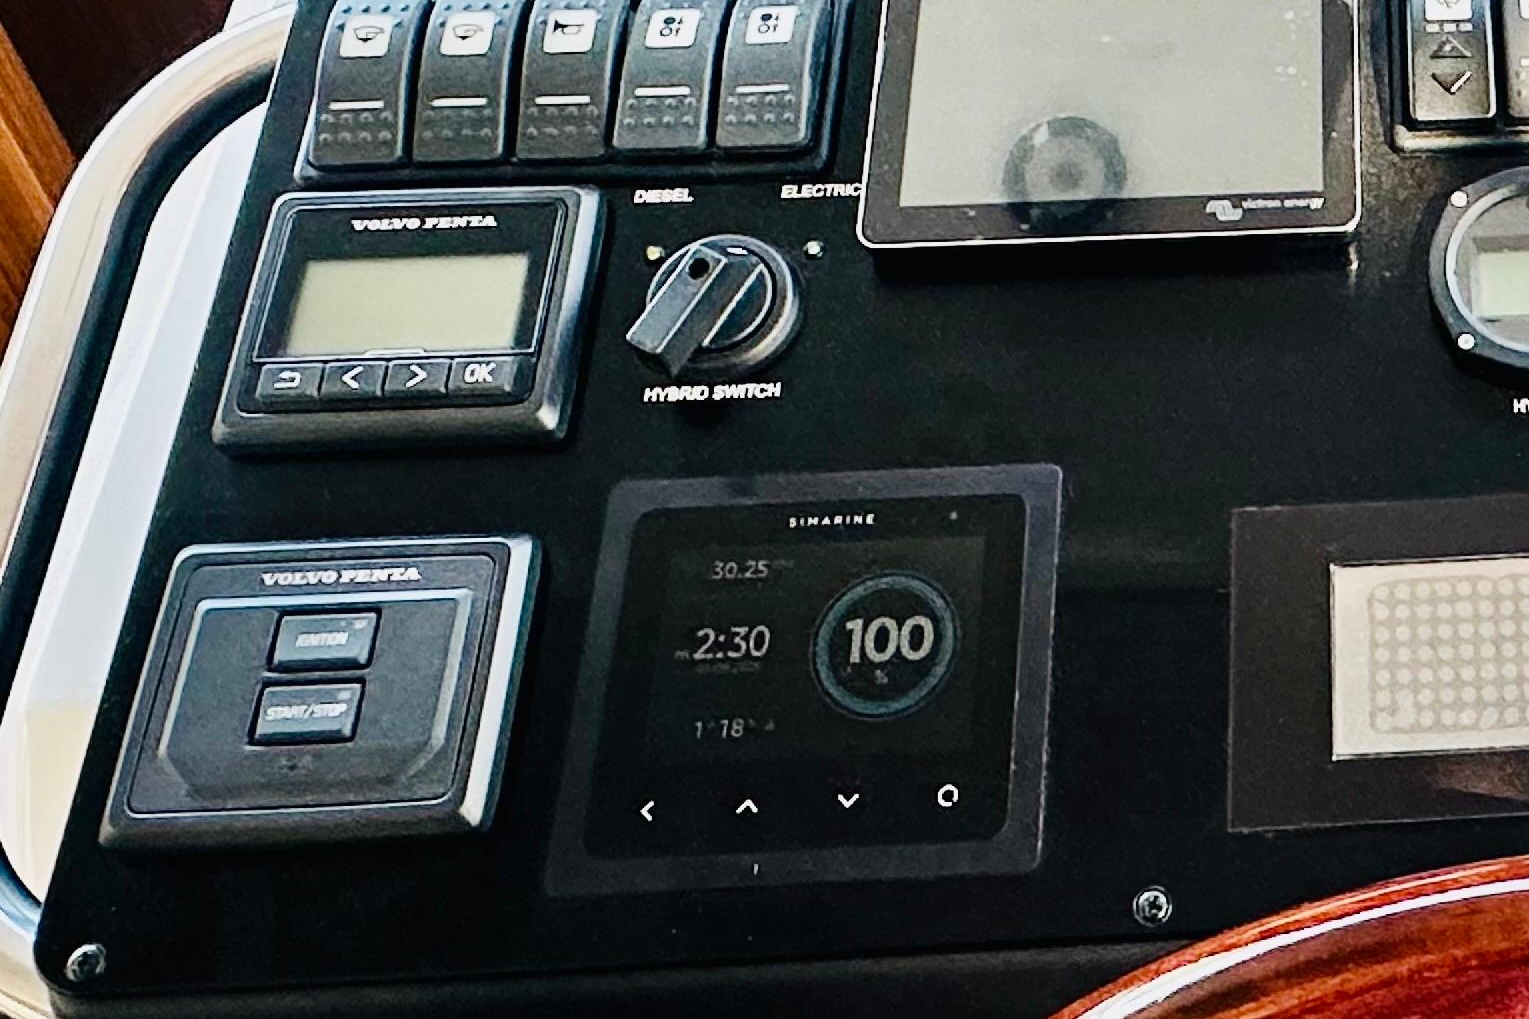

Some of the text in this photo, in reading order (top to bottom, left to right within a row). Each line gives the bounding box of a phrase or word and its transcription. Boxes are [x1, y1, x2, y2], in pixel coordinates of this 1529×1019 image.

[633, 187, 695, 204] DIESEL
[780, 183, 863, 199] ELECTRIC
[351, 215, 498, 231] VOLVO PENTA
[463, 362, 496, 384] OK
[643, 381, 782, 402] HYBRID SWITCH
[789, 513, 875, 529] SIMARINE
[261, 567, 422, 586] VOLVO PENTA
[711, 559, 769, 580] 30.25
[692, 625, 771, 661] 2:30
[845, 614, 935, 664] 100
